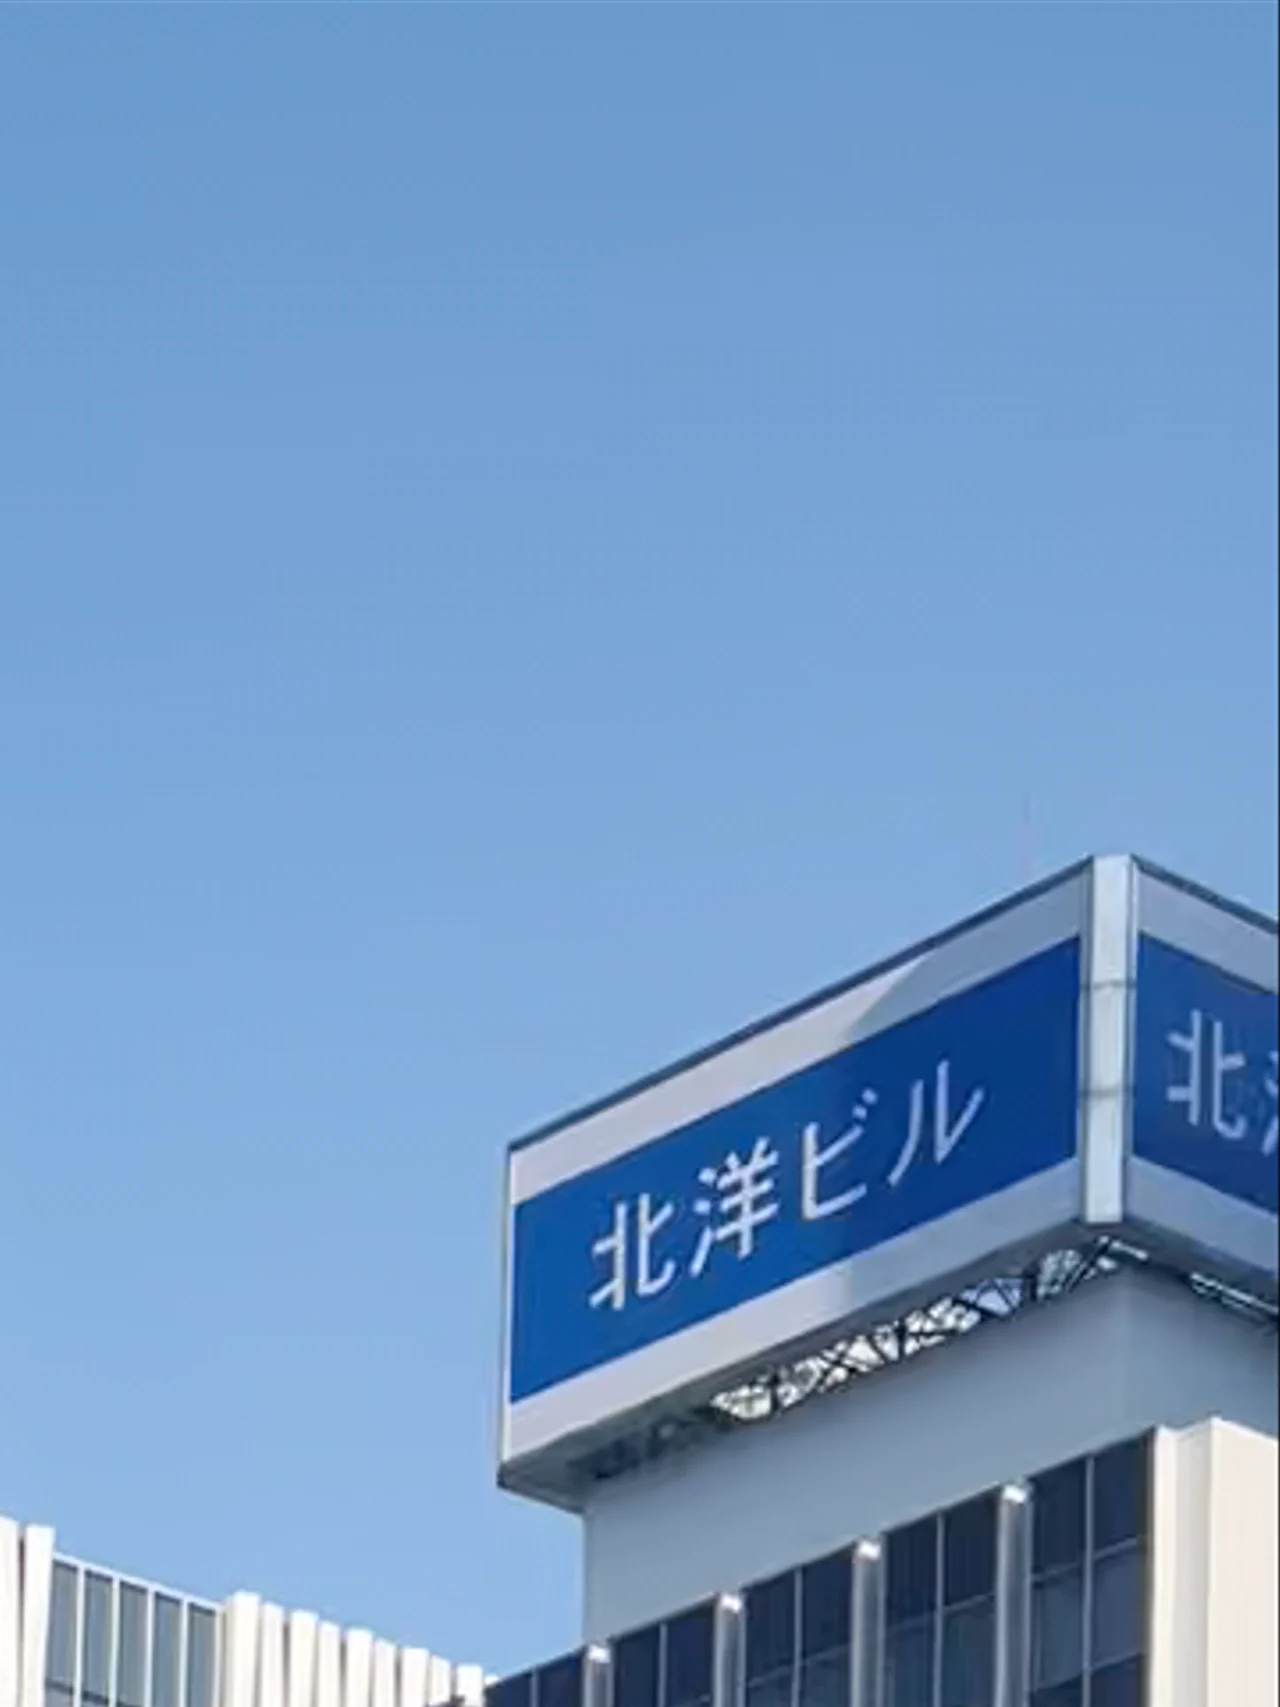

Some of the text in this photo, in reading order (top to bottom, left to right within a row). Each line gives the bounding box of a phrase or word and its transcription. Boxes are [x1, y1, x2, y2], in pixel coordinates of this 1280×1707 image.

[1165, 1009, 1278, 1156] 北
[589, 1060, 984, 1311] 北洋ビル
